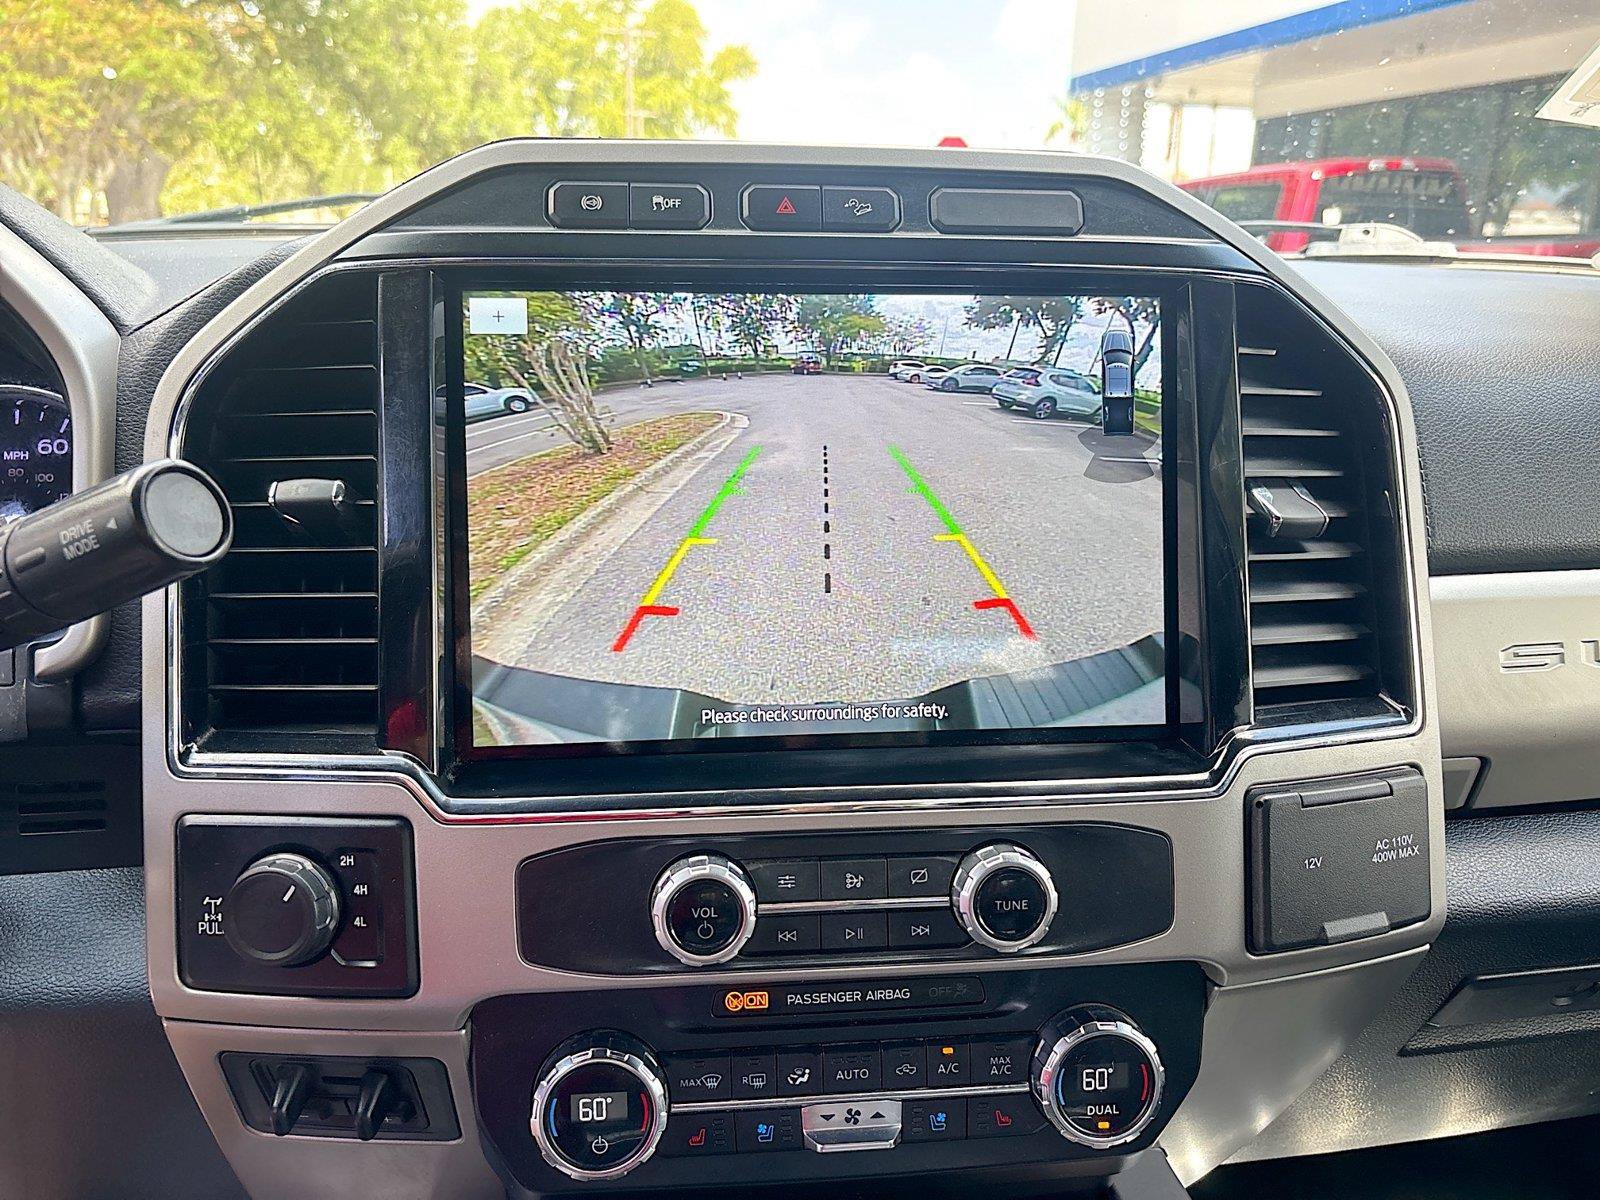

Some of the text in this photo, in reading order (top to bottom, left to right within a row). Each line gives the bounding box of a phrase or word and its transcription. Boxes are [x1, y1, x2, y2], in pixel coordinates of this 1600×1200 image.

[664, 198, 682, 209] OFF
[37, 439, 69, 455] 60
[3, 450, 29, 460] MPH
[8, 468, 25, 477] 80
[35, 473, 54, 482] 100
[60, 519, 95, 543] DRIVE
[63, 535, 100, 560] MODE
[701, 702, 949, 724] Please check surroundings for safety.
[1375, 834, 1414, 850] AC 110V
[1372, 845, 1420, 863] 400W MAX
[340, 855, 355, 867] 2H
[1304, 857, 1323, 869] 12V
[353, 884, 368, 896] 4H
[995, 899, 1029, 911] TUNE
[691, 907, 719, 919] VOL
[353, 916, 367, 927] 4L
[198, 921, 224, 935] PUL
[746, 995, 766, 1006] ON
[787, 991, 862, 1006] PASSENGER
[866, 988, 911, 1000] AIRBAG
[990, 1056, 1011, 1066] MAX
[835, 1069, 869, 1081] AUTO
[938, 1063, 960, 1075] A/C
[990, 1065, 1012, 1077] A/C
[680, 1078, 702, 1088] MAX
[742, 1076, 749, 1086] R
[1084, 1068, 1114, 1092] 60°
[578, 1097, 613, 1123] 60°
[1087, 1104, 1120, 1116] DUAL
